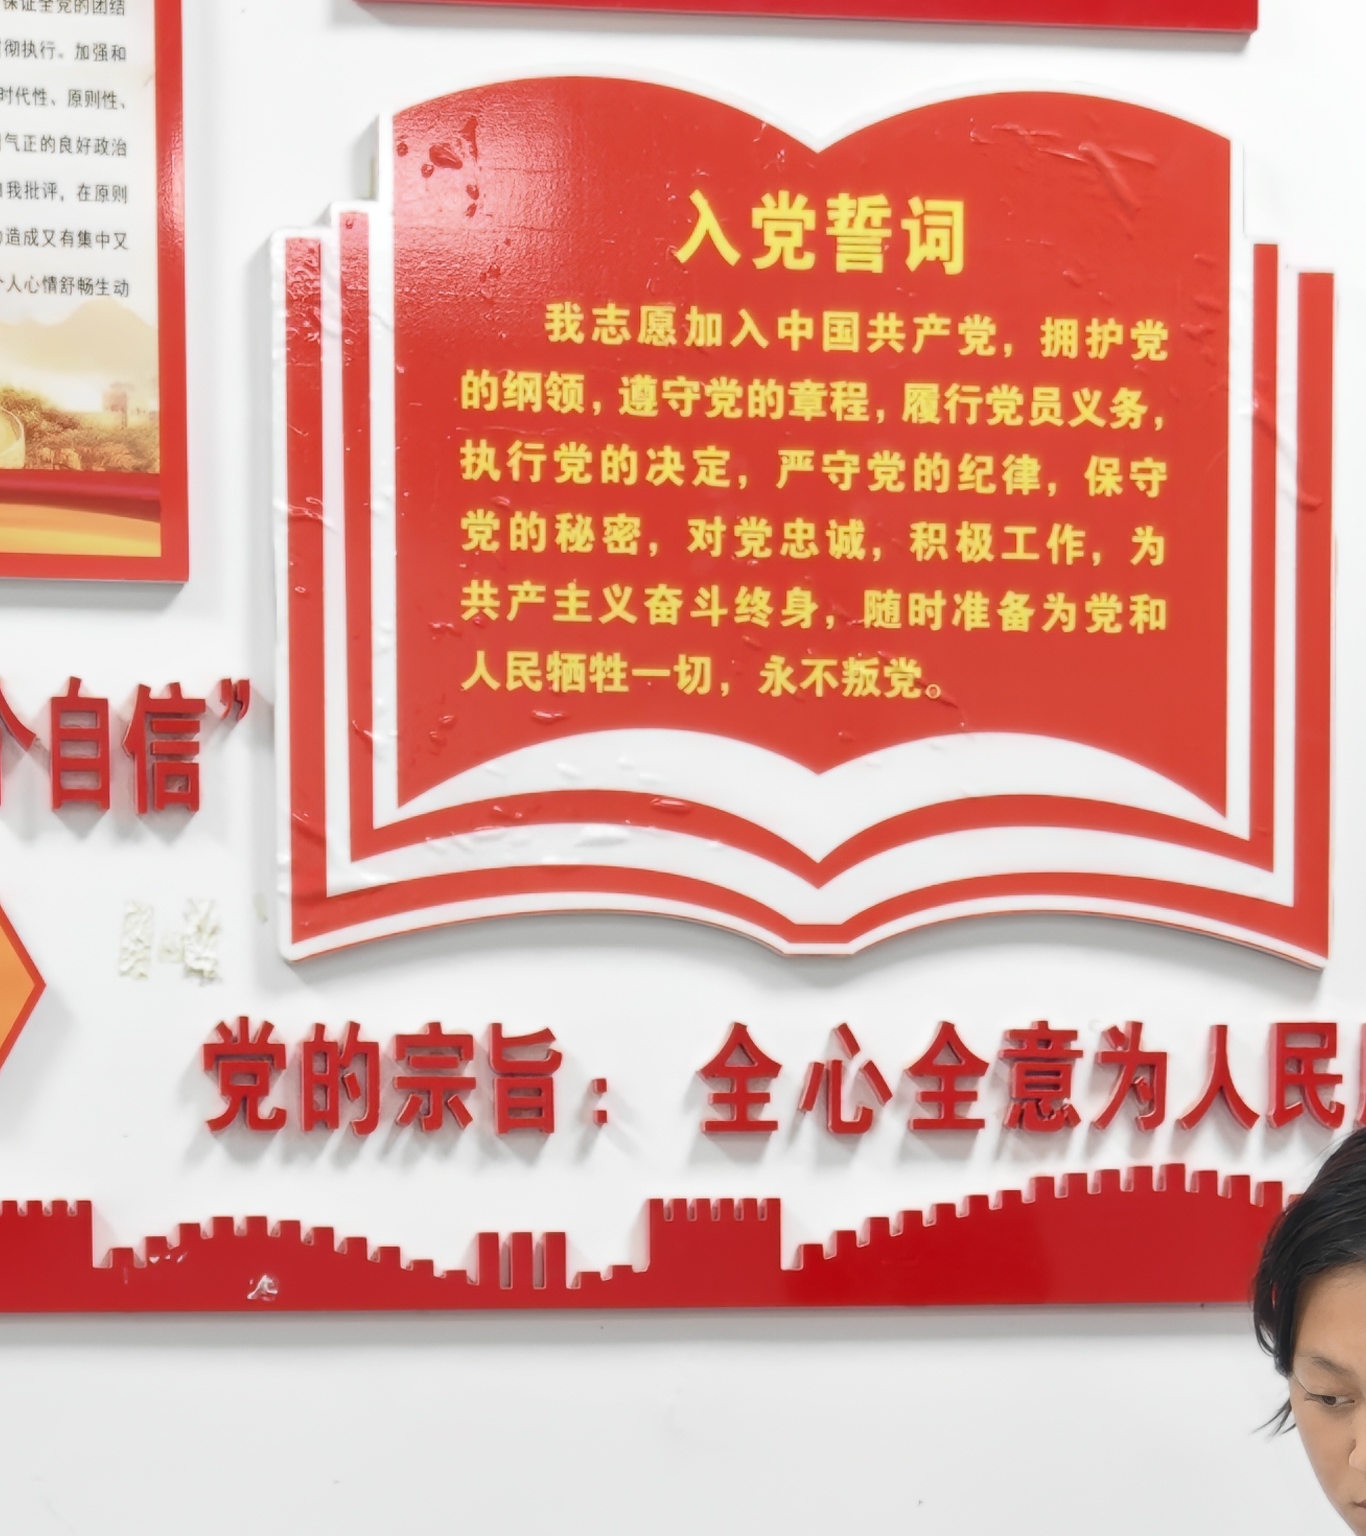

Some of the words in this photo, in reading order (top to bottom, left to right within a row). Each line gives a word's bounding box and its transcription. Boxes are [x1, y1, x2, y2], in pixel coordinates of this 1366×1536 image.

[674, 189, 968, 275] 入党誓词
[544, 300, 1171, 362] 我志愿加入中国共产党,拥护党
[460, 438, 1169, 499] 执行党的决定,严守党的纪律,保守
[460, 509, 1167, 568] 党的秘密,对党忠诚,积极工作,为
[460, 579, 1169, 636] 共产主义奋斗终身,随时准备为党和
[461, 648, 944, 704] 人民牺牲一切,永不叛党。
